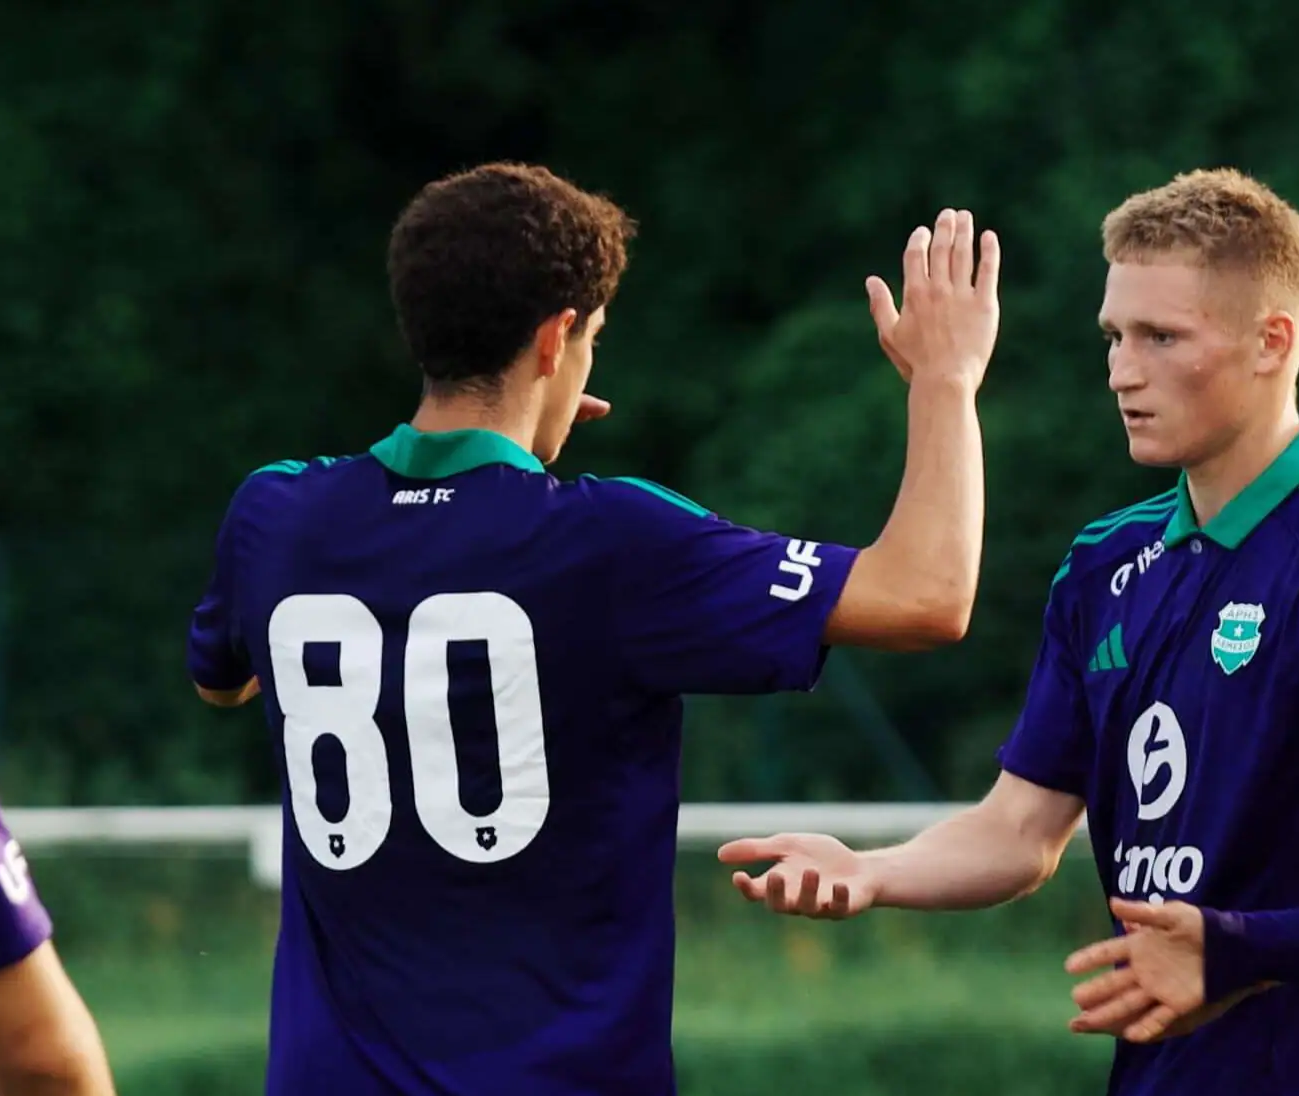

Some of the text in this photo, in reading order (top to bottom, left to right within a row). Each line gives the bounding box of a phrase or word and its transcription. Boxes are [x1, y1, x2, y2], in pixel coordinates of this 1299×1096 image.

[392, 487, 456, 505] ARIS FC
[268, 591, 551, 871] 80
